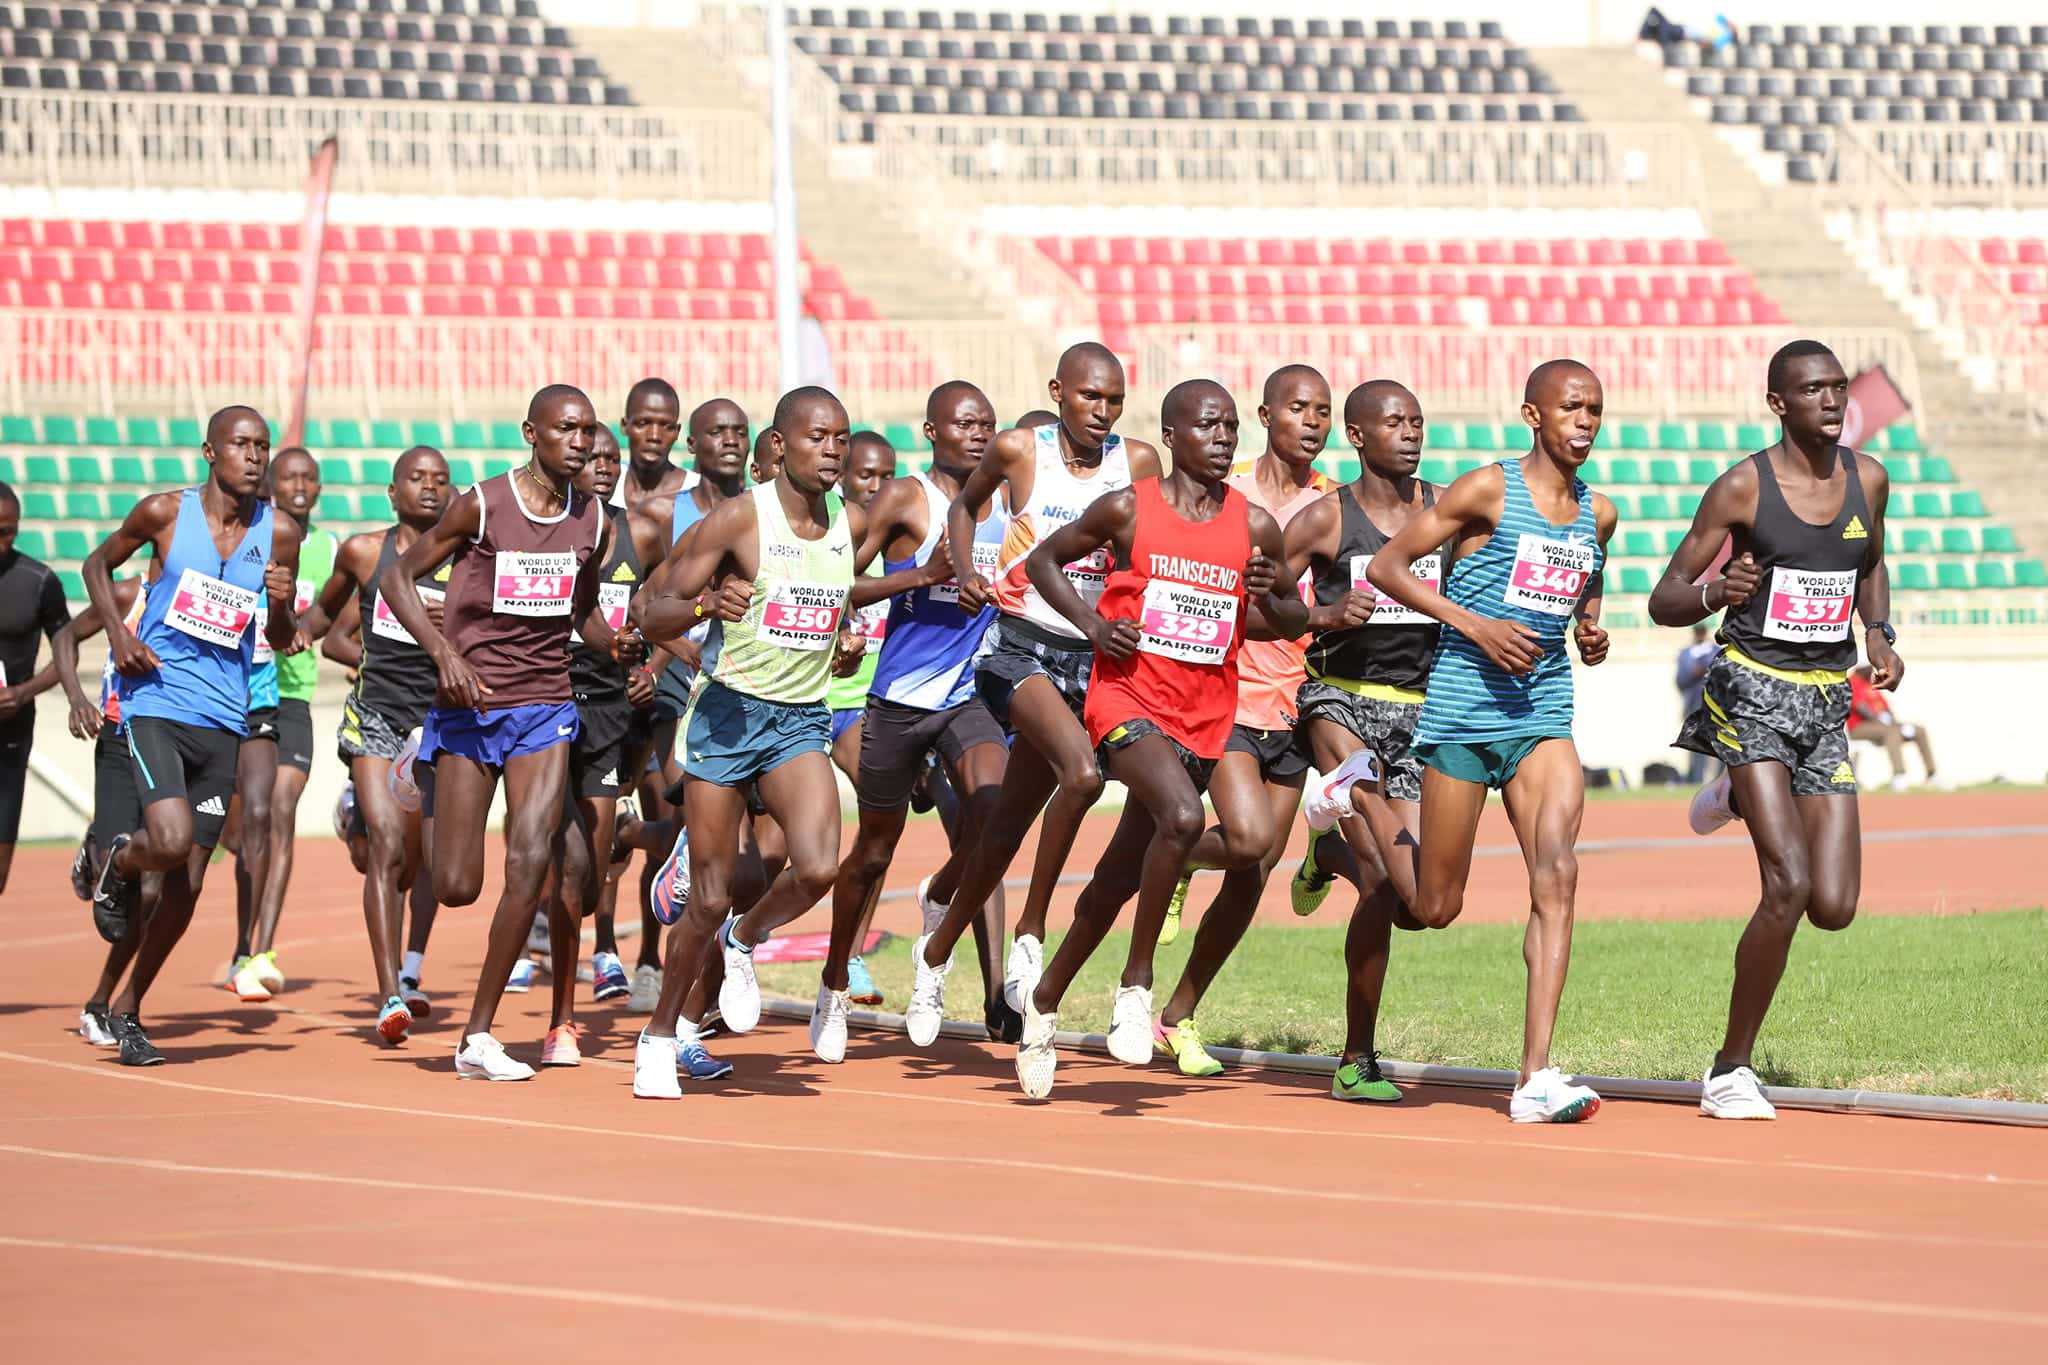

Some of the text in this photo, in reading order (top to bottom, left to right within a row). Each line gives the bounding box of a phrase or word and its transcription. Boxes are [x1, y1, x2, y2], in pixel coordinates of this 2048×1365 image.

[1542, 544, 1574, 558] WORLD
[518, 558, 571, 566] WORLD U-20
[974, 557, 996, 565] IALS
[1415, 560, 1436, 568] U-20
[1547, 556, 1584, 570] TRIALS
[524, 567, 564, 575] TRIALS
[1149, 553, 1239, 591] TRANSCEND
[1526, 564, 1580, 593] 340
[512, 577, 561, 596] 341
[1797, 575, 1836, 586] WORLD
[201, 580, 254, 605] WORLD U-20
[790, 586, 845, 599] WORLD U-20
[1804, 586, 1847, 597] TRIALS
[205, 590, 242, 609] TRIALS
[795, 597, 836, 607] TRIALS
[1170, 592, 1232, 610] WORLD U-20
[186, 596, 236, 627] 333
[1176, 604, 1222, 619] TRIALS
[1786, 597, 1845, 620] 337
[777, 606, 832, 630] 350
[177, 614, 235, 639] NAIROBI
[769, 628, 832, 640] NAIROBI
[1157, 612, 1219, 642] 329
[1777, 622, 1844, 633] NAIROBI
[1148, 636, 1220, 655] NAIROBI
